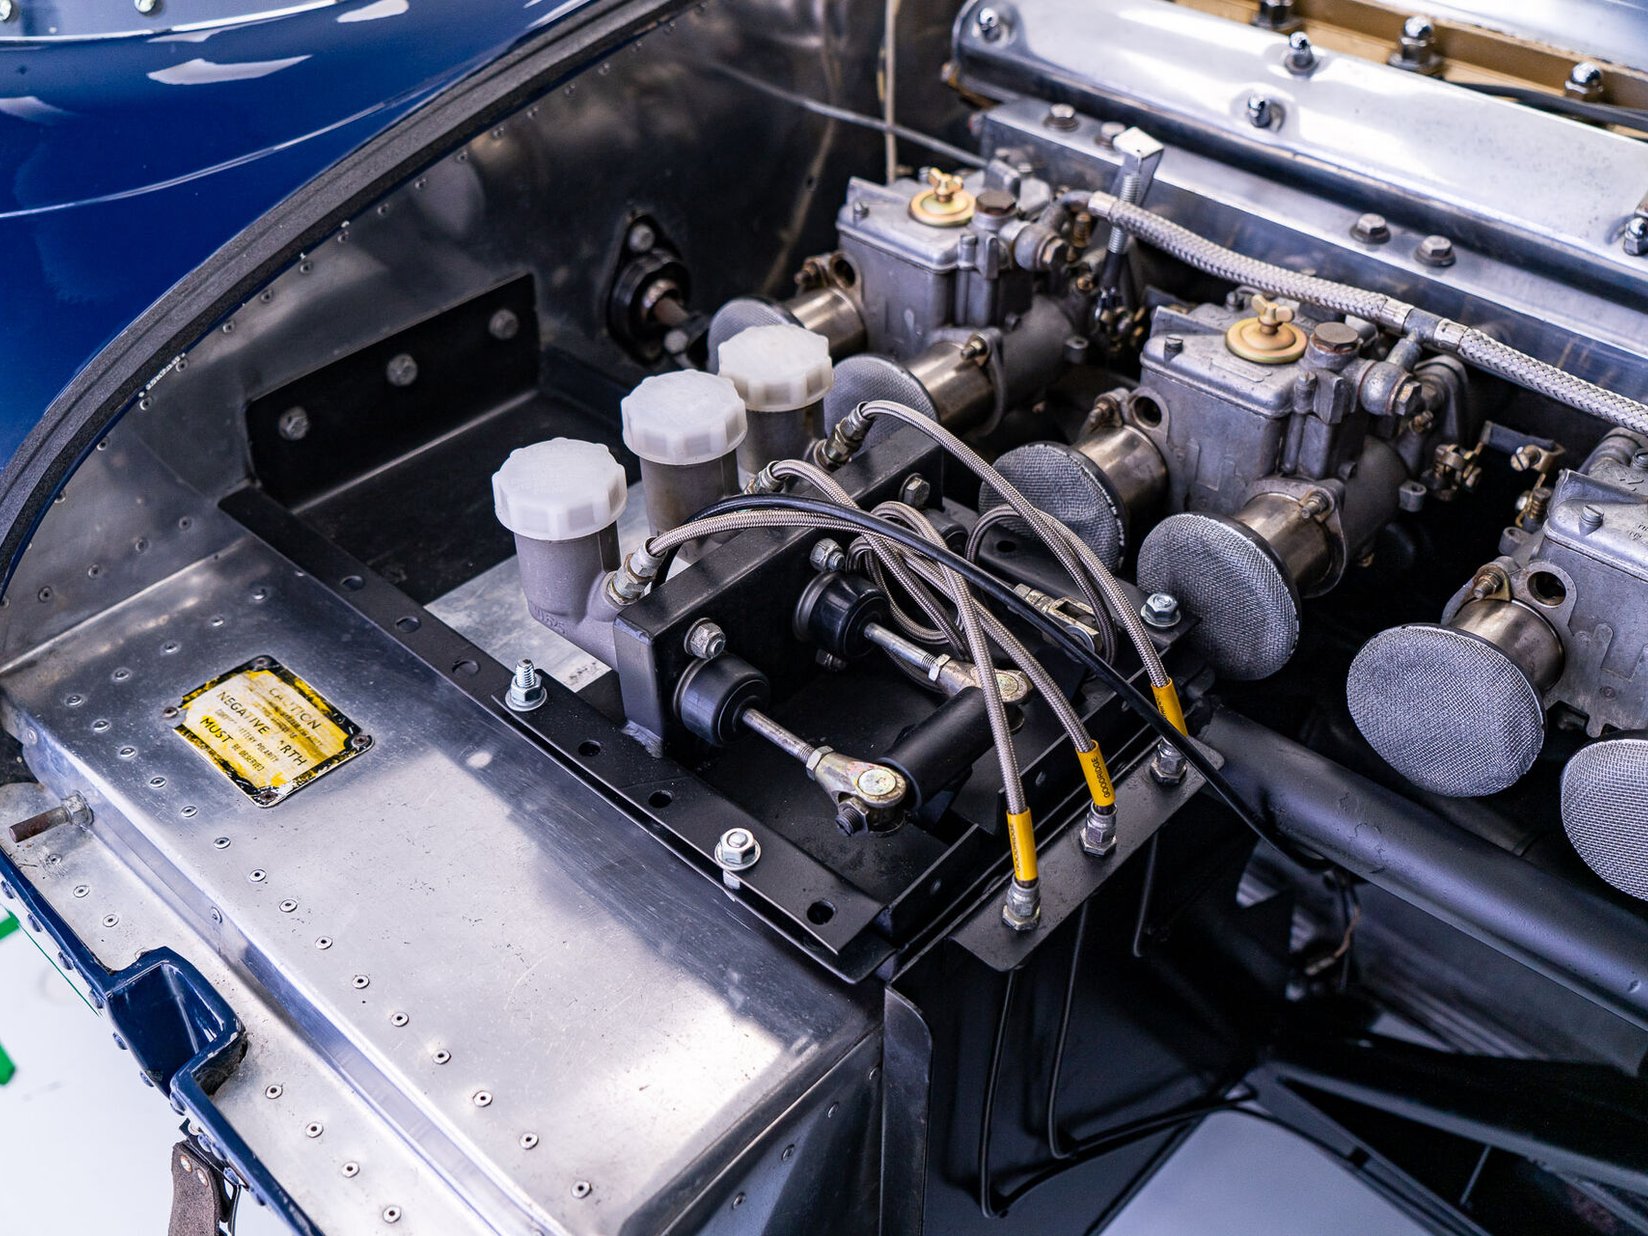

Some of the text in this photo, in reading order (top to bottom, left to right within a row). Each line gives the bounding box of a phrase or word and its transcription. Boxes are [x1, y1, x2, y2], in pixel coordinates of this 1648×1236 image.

[199, 716, 234, 744] MUST
[216, 690, 271, 735] NEGATIVE
[272, 737, 309, 767] RTH
[1091, 756, 1111, 799] GOODRIDGE
